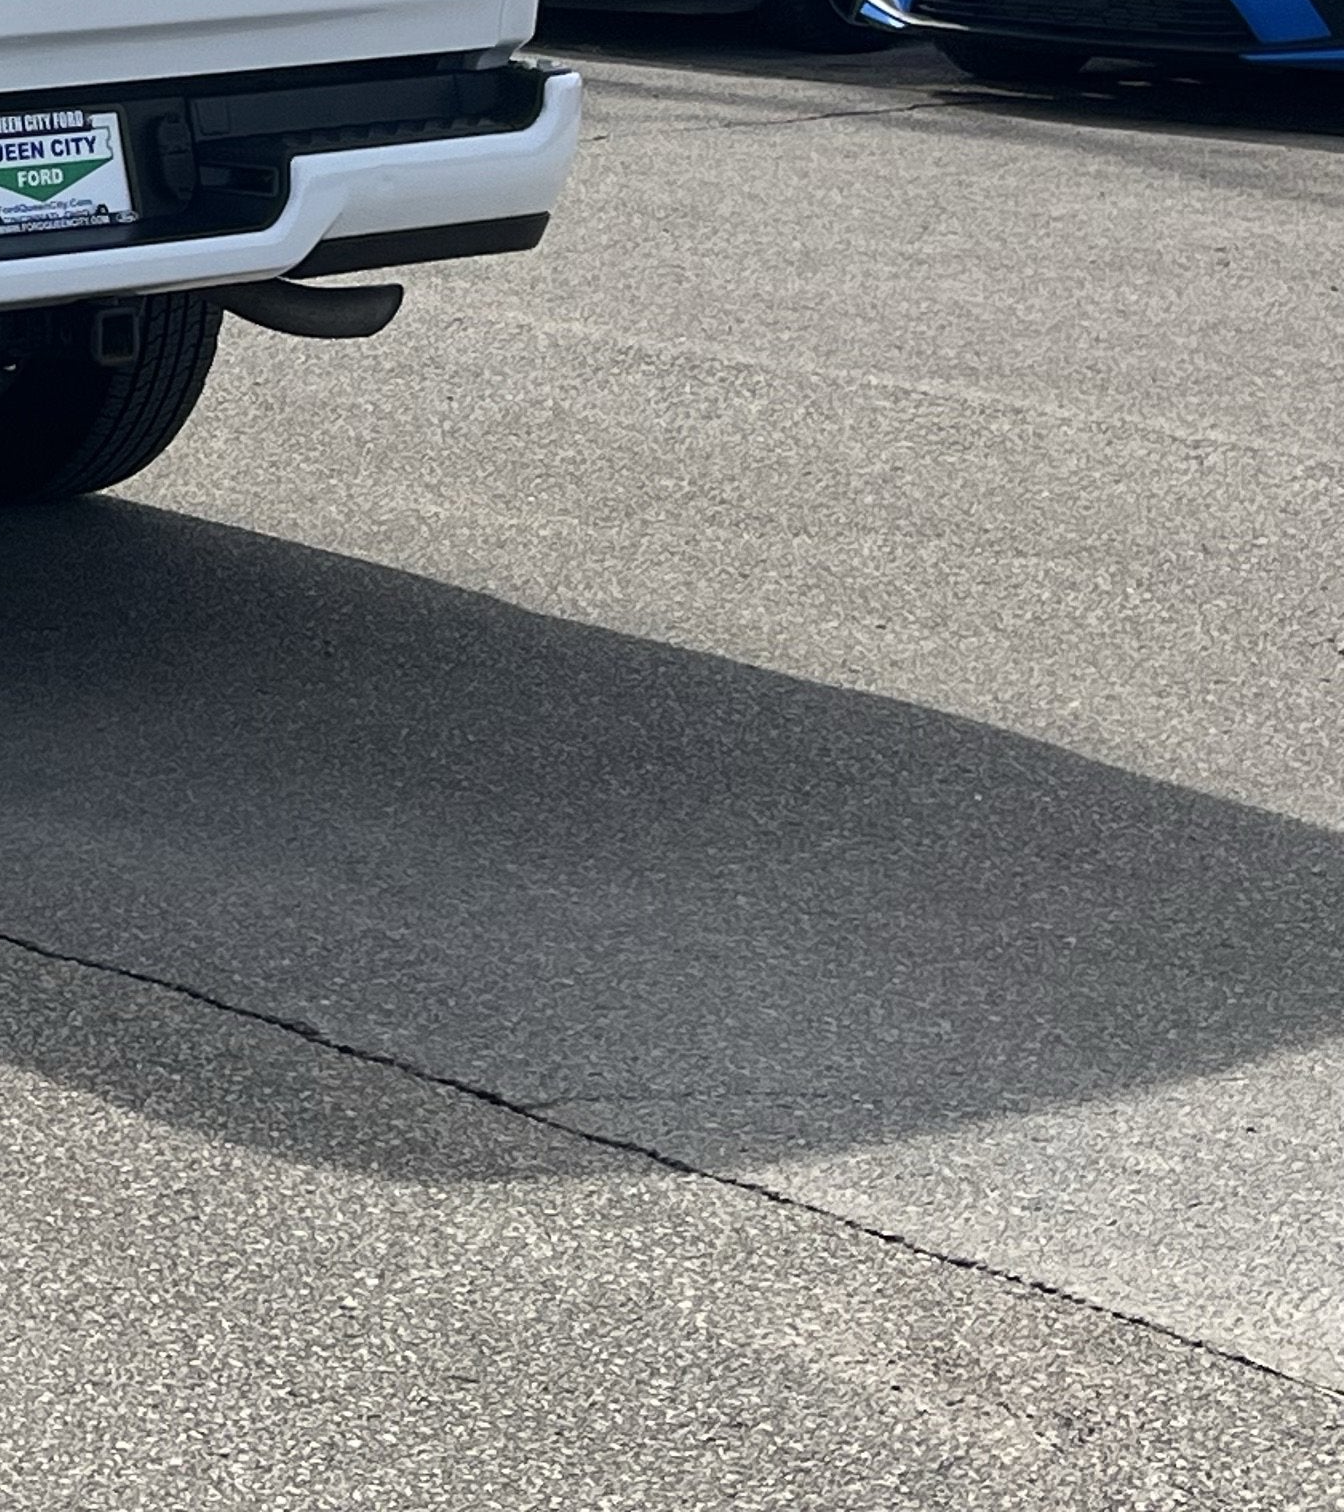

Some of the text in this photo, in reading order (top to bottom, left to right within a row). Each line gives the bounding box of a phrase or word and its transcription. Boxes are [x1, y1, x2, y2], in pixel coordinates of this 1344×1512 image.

[24, 112, 52, 133] CITY
[53, 110, 84, 129] FORD
[50, 136, 97, 157] CITY
[17, 169, 64, 188] FORD
